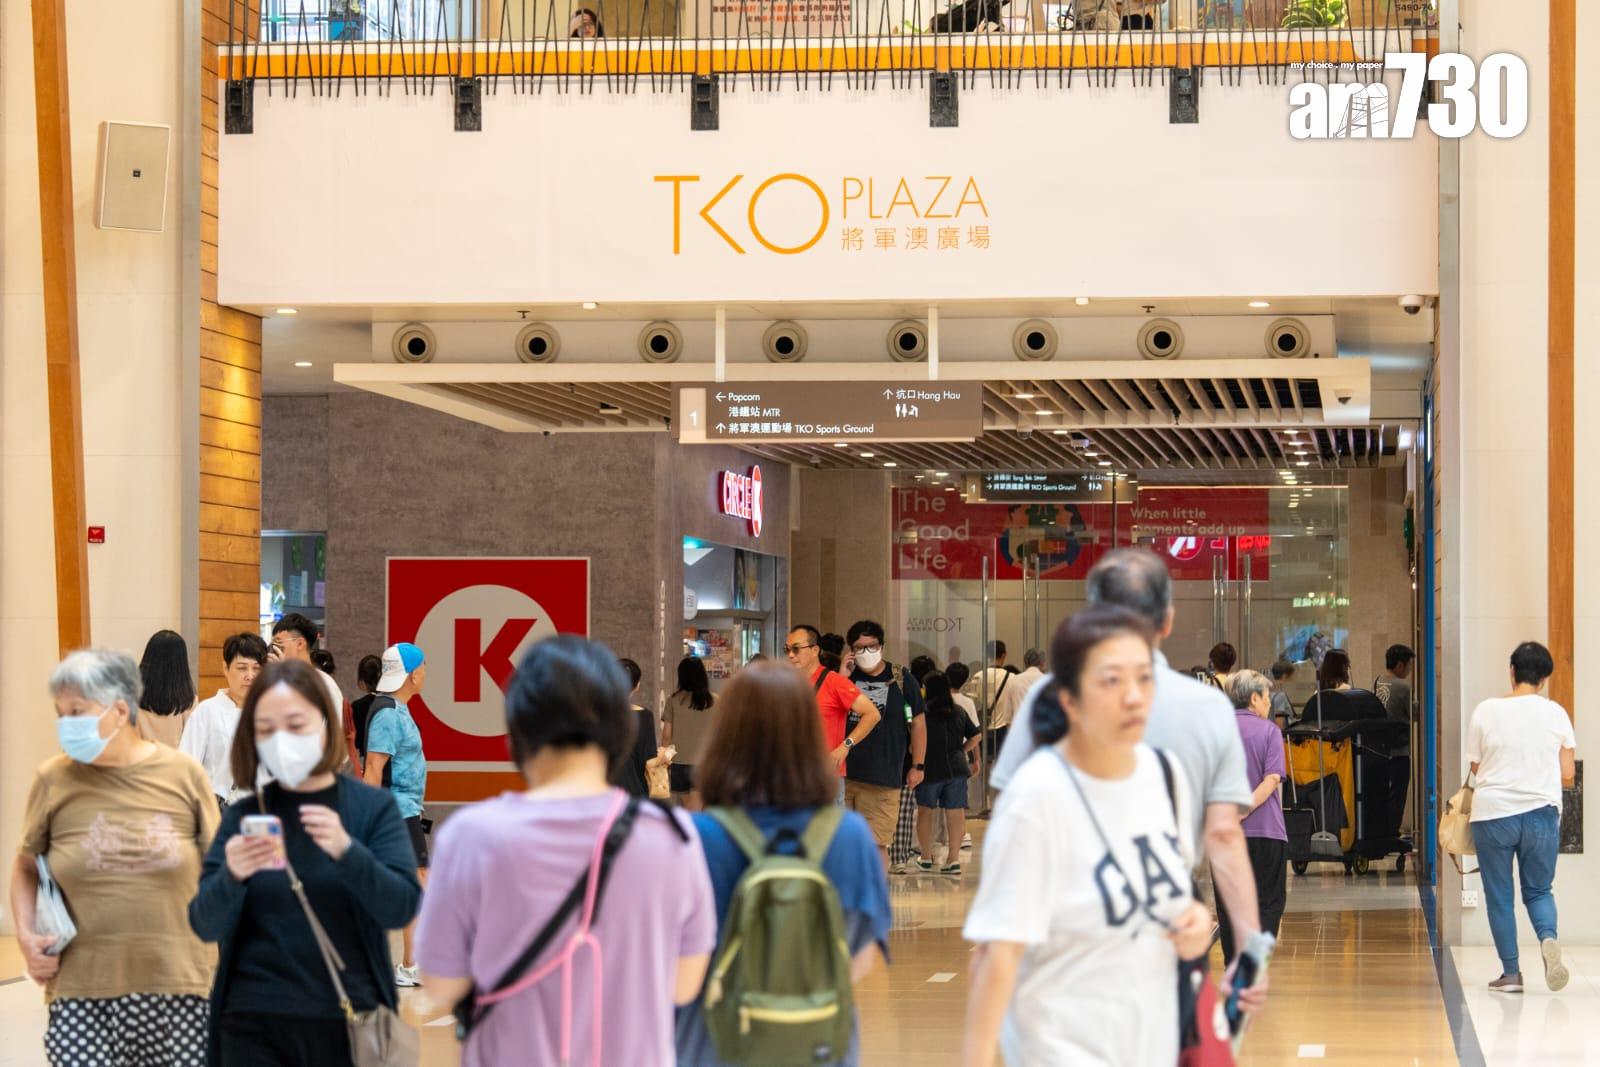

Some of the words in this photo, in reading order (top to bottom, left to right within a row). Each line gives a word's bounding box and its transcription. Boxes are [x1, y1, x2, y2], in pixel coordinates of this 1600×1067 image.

[653, 173, 830, 255] TKO
[842, 176, 989, 219] PLAZA
[840, 225, 991, 252] 將軍澳廣場
[728, 392, 761, 402] Popcorn
[917, 391, 941, 402] Hang
[943, 391, 961, 400] Hau
[689, 410, 697, 427] 1
[762, 408, 781, 417] MTR
[795, 424, 814, 433] TKO
[816, 424, 841, 435] Sports
[843, 424, 874, 434] Ground
[723, 469, 752, 520] CIRCLE
[898, 489, 946, 512] The
[1130, 507, 1169, 519] When
[1173, 507, 1206, 519] little
[1198, 523, 1224, 535] add
[1229, 524, 1246, 536] up
[899, 546, 948, 569] Life
[453, 618, 538, 703] K
[1094, 832, 1184, 928] GA
